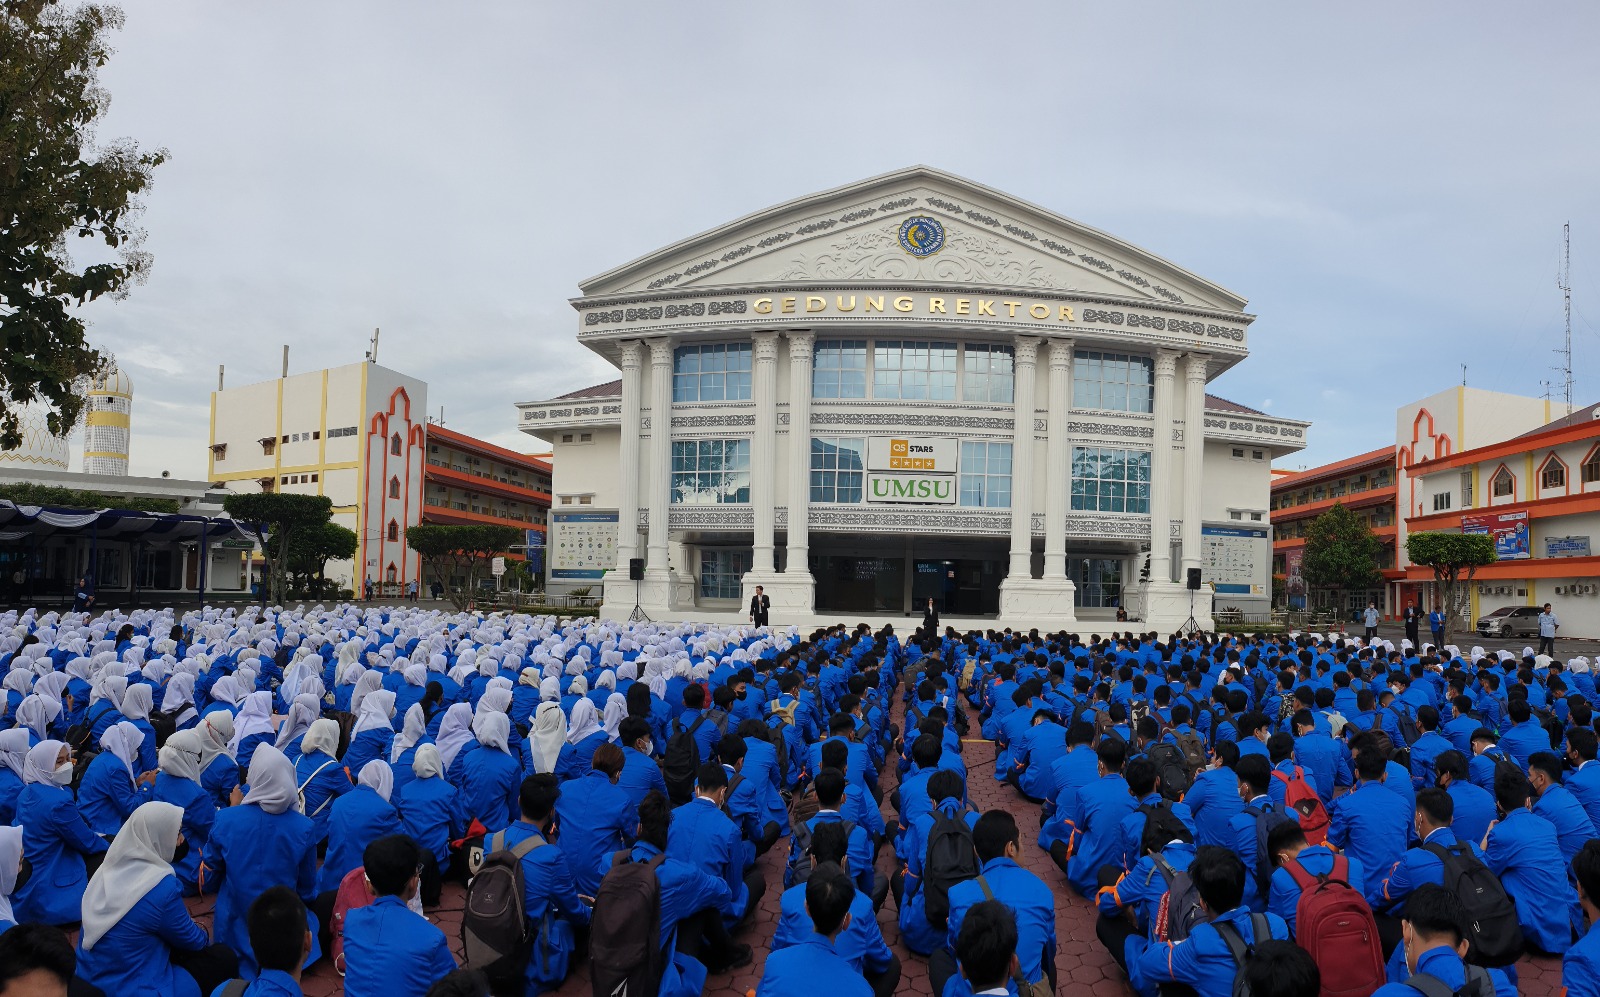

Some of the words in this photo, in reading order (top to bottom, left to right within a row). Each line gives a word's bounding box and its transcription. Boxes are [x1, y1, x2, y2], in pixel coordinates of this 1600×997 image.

[753, 295, 913, 314] GEDUNG
[929, 297, 1075, 322] REKTOR
[892, 443, 906, 452] QS
[909, 445, 934, 453] STARS
[872, 479, 951, 498] UMSU
